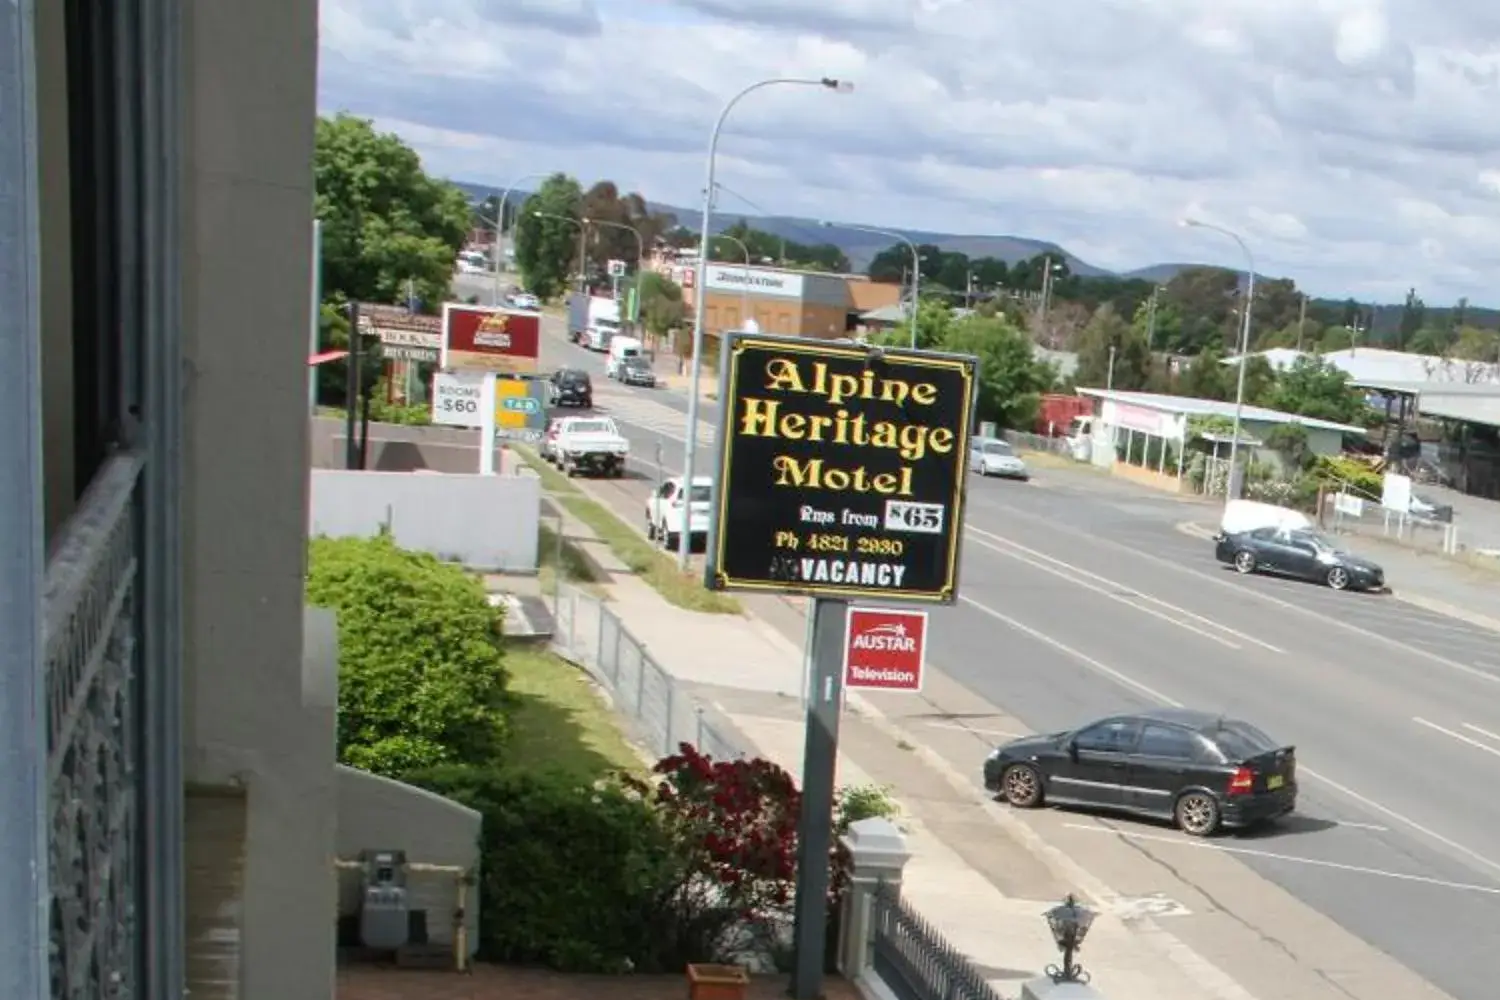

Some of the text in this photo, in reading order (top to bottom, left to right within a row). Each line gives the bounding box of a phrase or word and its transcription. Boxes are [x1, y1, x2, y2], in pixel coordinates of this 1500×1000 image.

[764, 358, 938, 408] Alpine
[740, 397, 954, 460] Heritage
[773, 455, 913, 495] Motel
[799, 505, 939, 528] Rms from $65
[775, 531, 799, 550] Ph
[800, 558, 906, 587] VACANCY
[853, 633, 916, 652] AUSTAR
